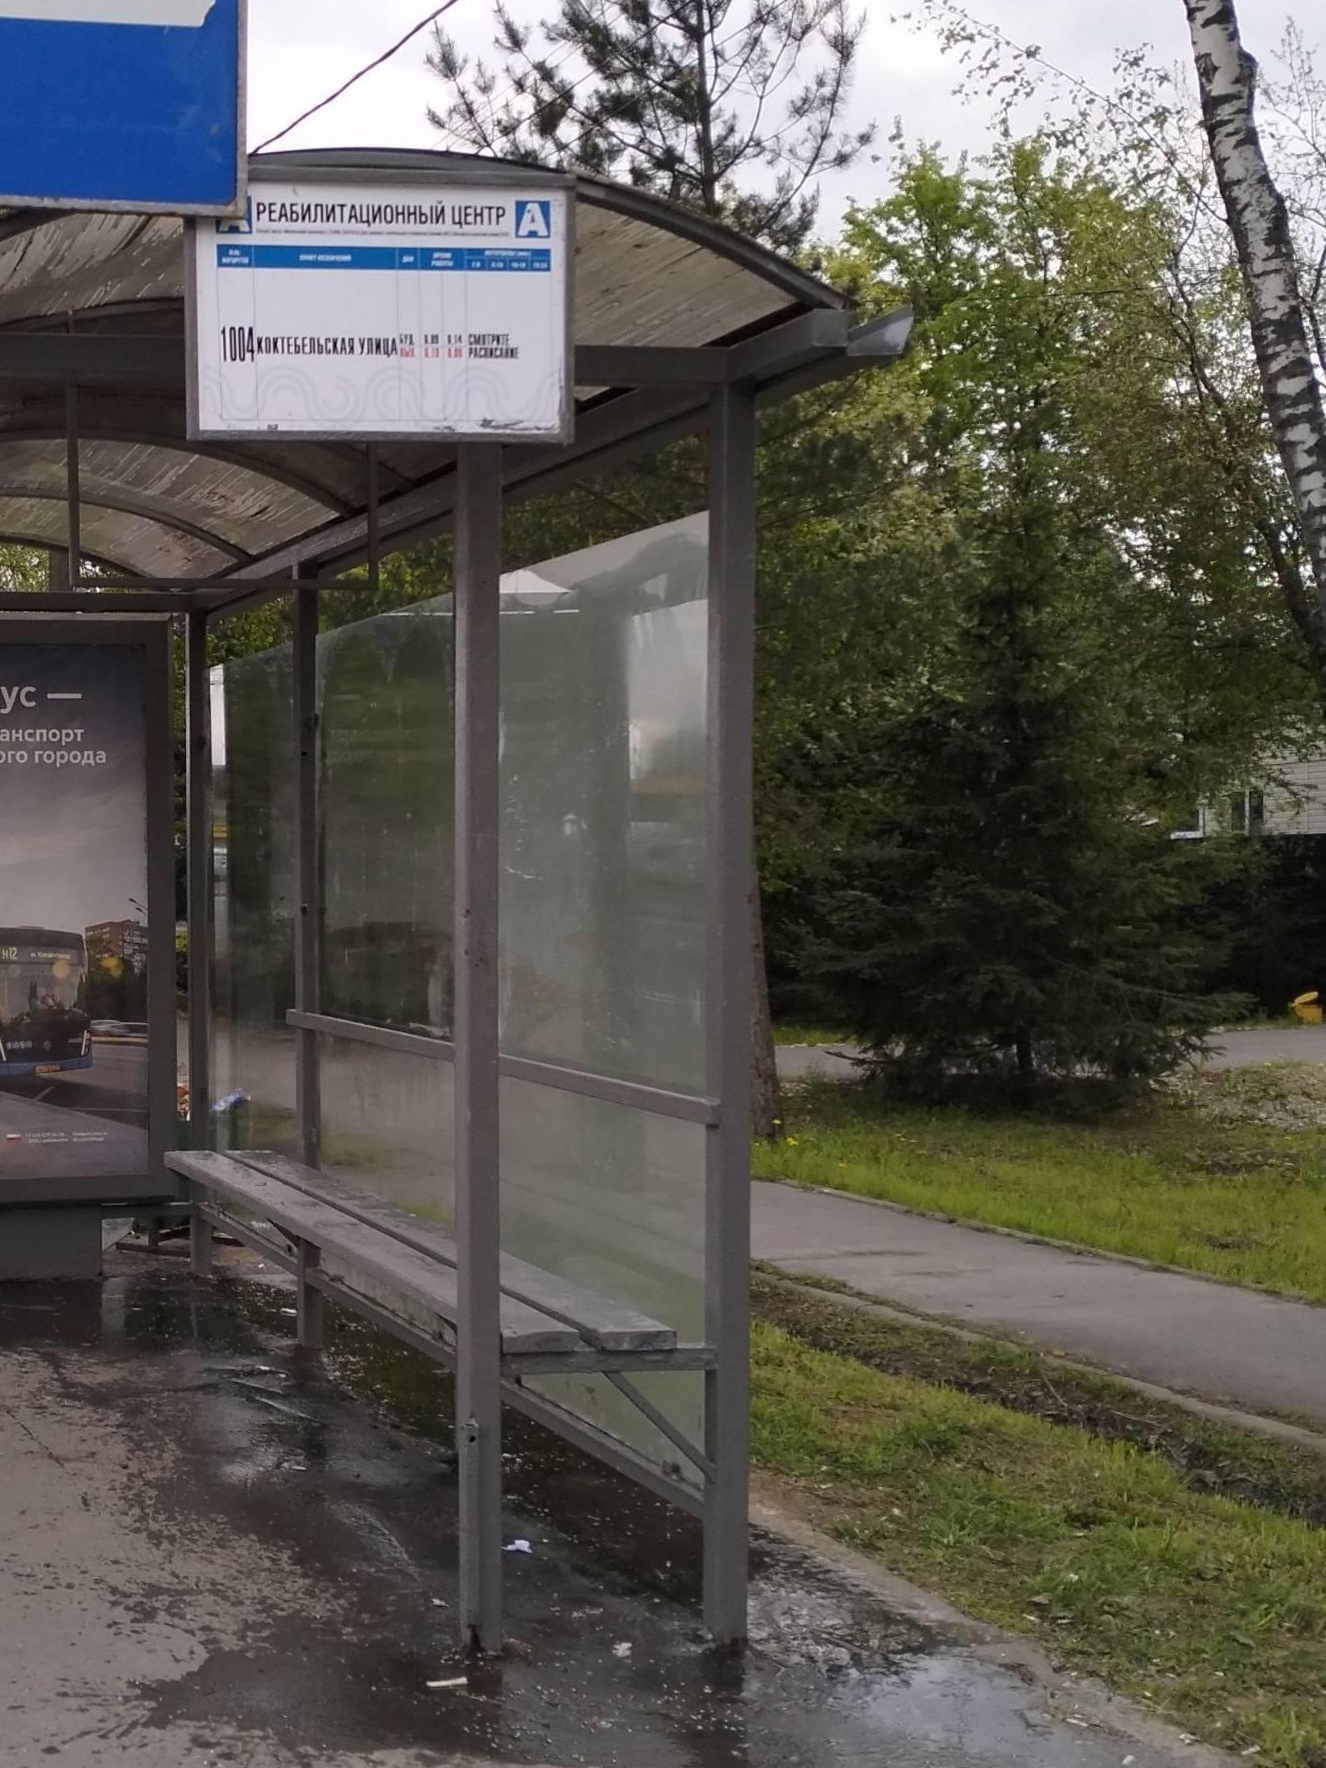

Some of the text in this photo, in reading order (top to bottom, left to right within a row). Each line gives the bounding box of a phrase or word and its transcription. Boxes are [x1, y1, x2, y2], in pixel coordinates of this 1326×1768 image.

[256, 201, 445, 228] РЕАБИЛИТАЦИОННЫЙ
[452, 205, 506, 229] ЦЕНТР
[221, 326, 398, 362] 1004 КОКТЕБЕЛЬСКАЯ УЛИЦА
[34, 750, 107, 767] города
